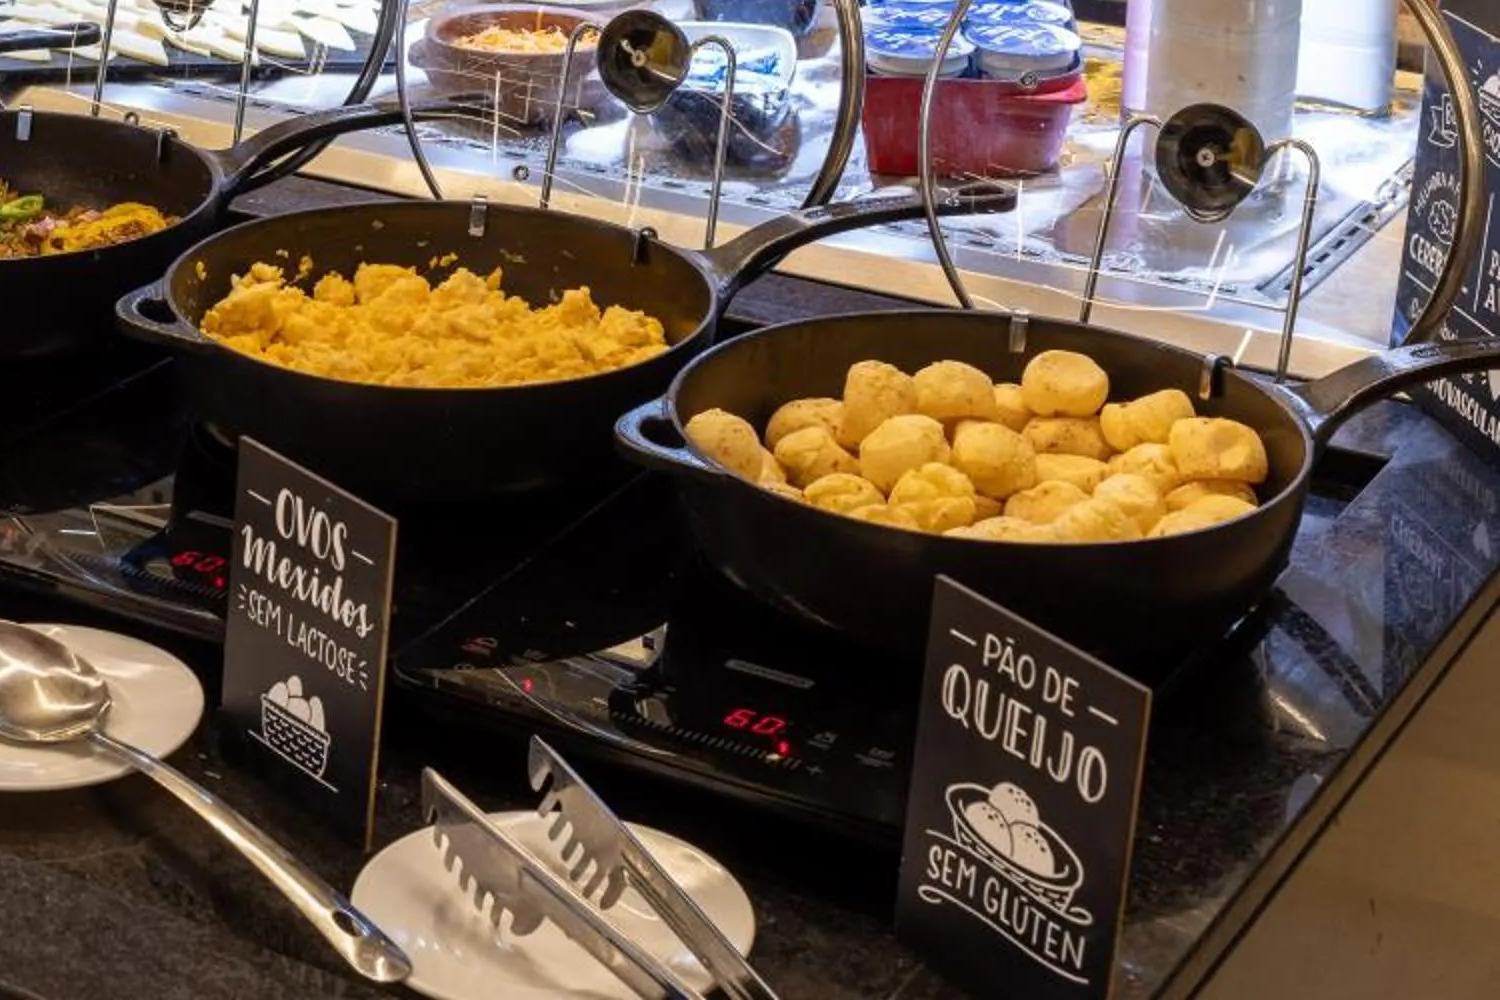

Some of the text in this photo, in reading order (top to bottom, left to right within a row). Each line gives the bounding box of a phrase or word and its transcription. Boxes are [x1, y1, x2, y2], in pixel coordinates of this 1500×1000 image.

[1408, 232, 1451, 281] CEREB
[172, 551, 226, 573] 60
[275, 487, 348, 572] OVOS
[241, 523, 375, 639] Mexidos
[248, 589, 358, 685] SEM LACTOSE
[982, 632, 1080, 717] PÃO DE
[723, 708, 787, 735] 60
[942, 664, 1107, 803] QUEIJO
[926, 845, 1086, 970] SEM GLÚTEN
